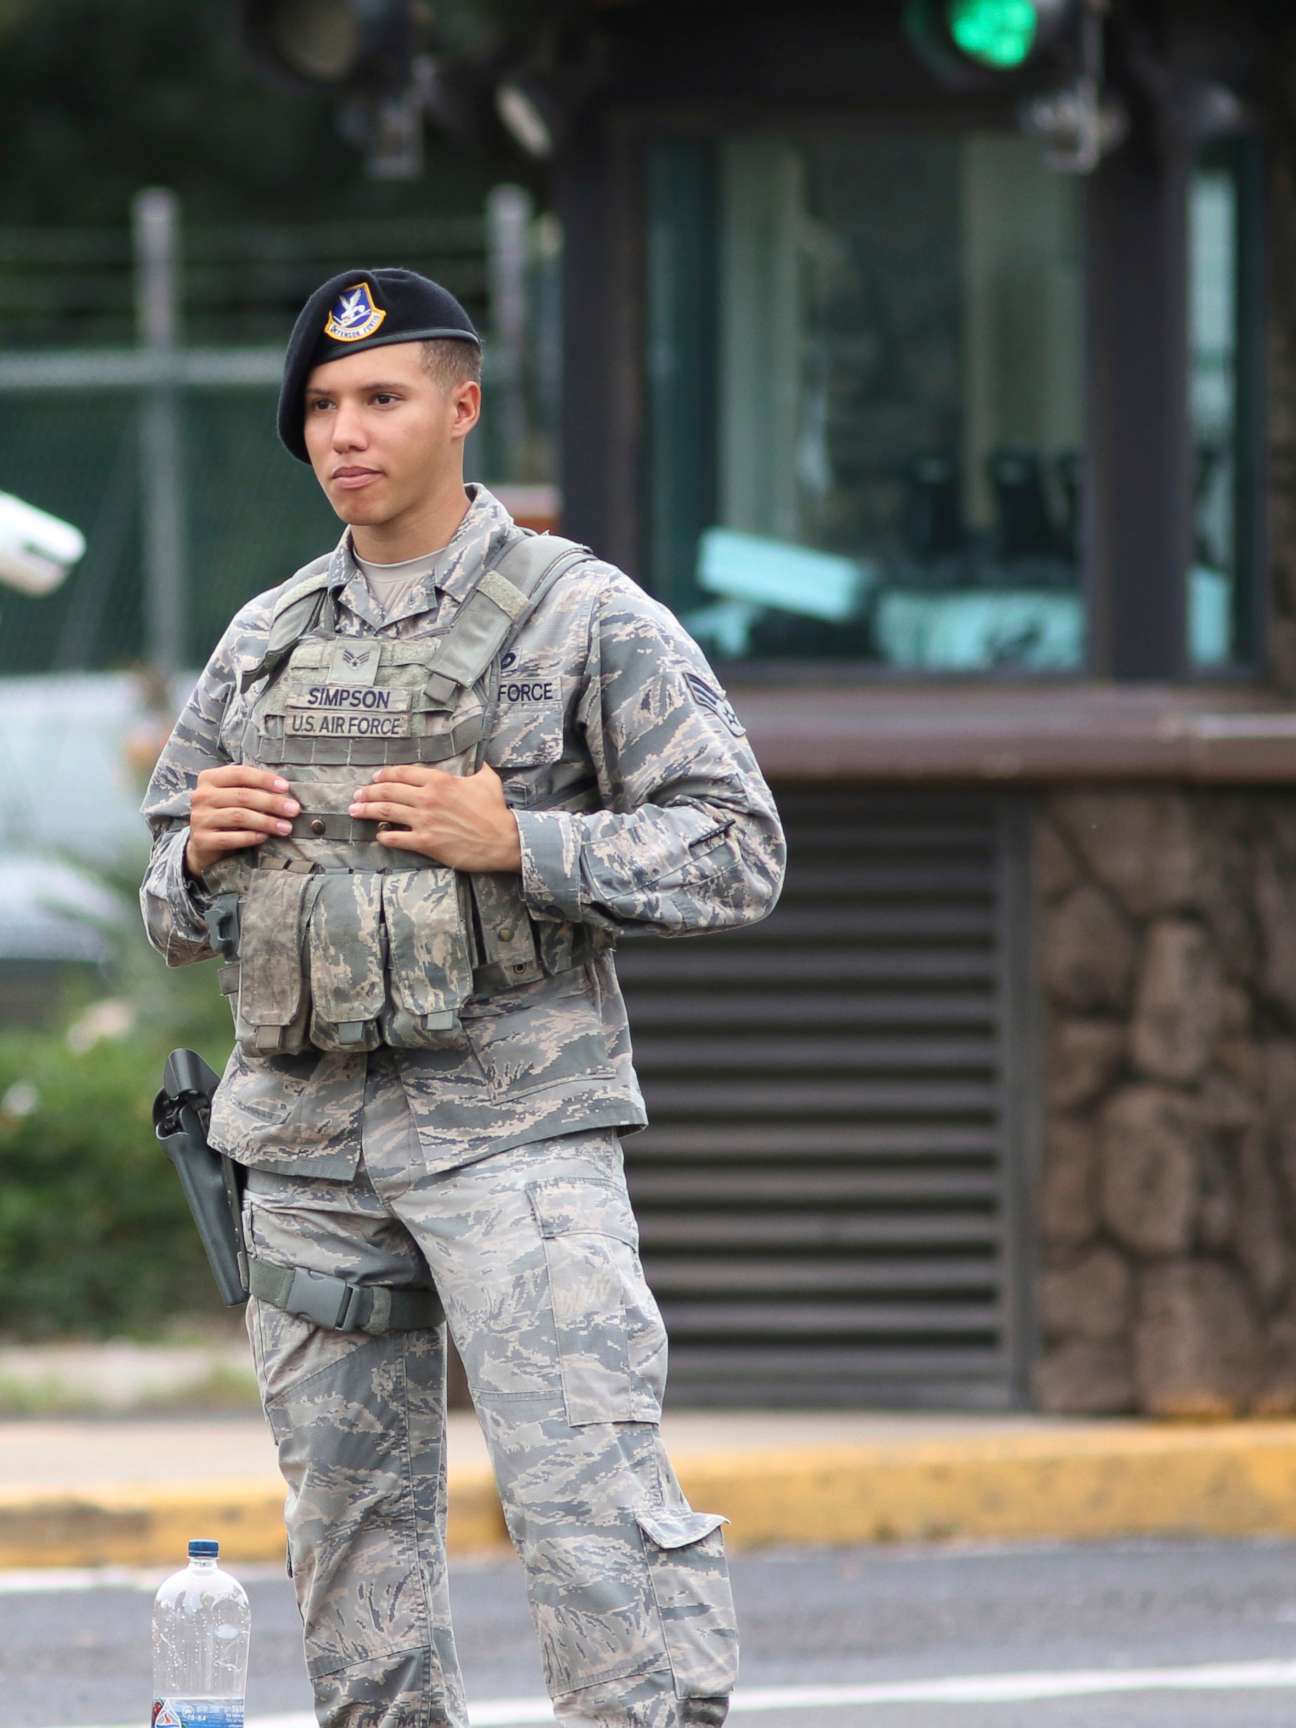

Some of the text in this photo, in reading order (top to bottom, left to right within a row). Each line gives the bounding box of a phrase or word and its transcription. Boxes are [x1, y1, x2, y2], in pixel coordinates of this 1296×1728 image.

[307, 687, 391, 709] SIMPSON
[497, 682, 553, 702] FORCE
[319, 716, 346, 734] AIR
[347, 716, 401, 735] FORCE
